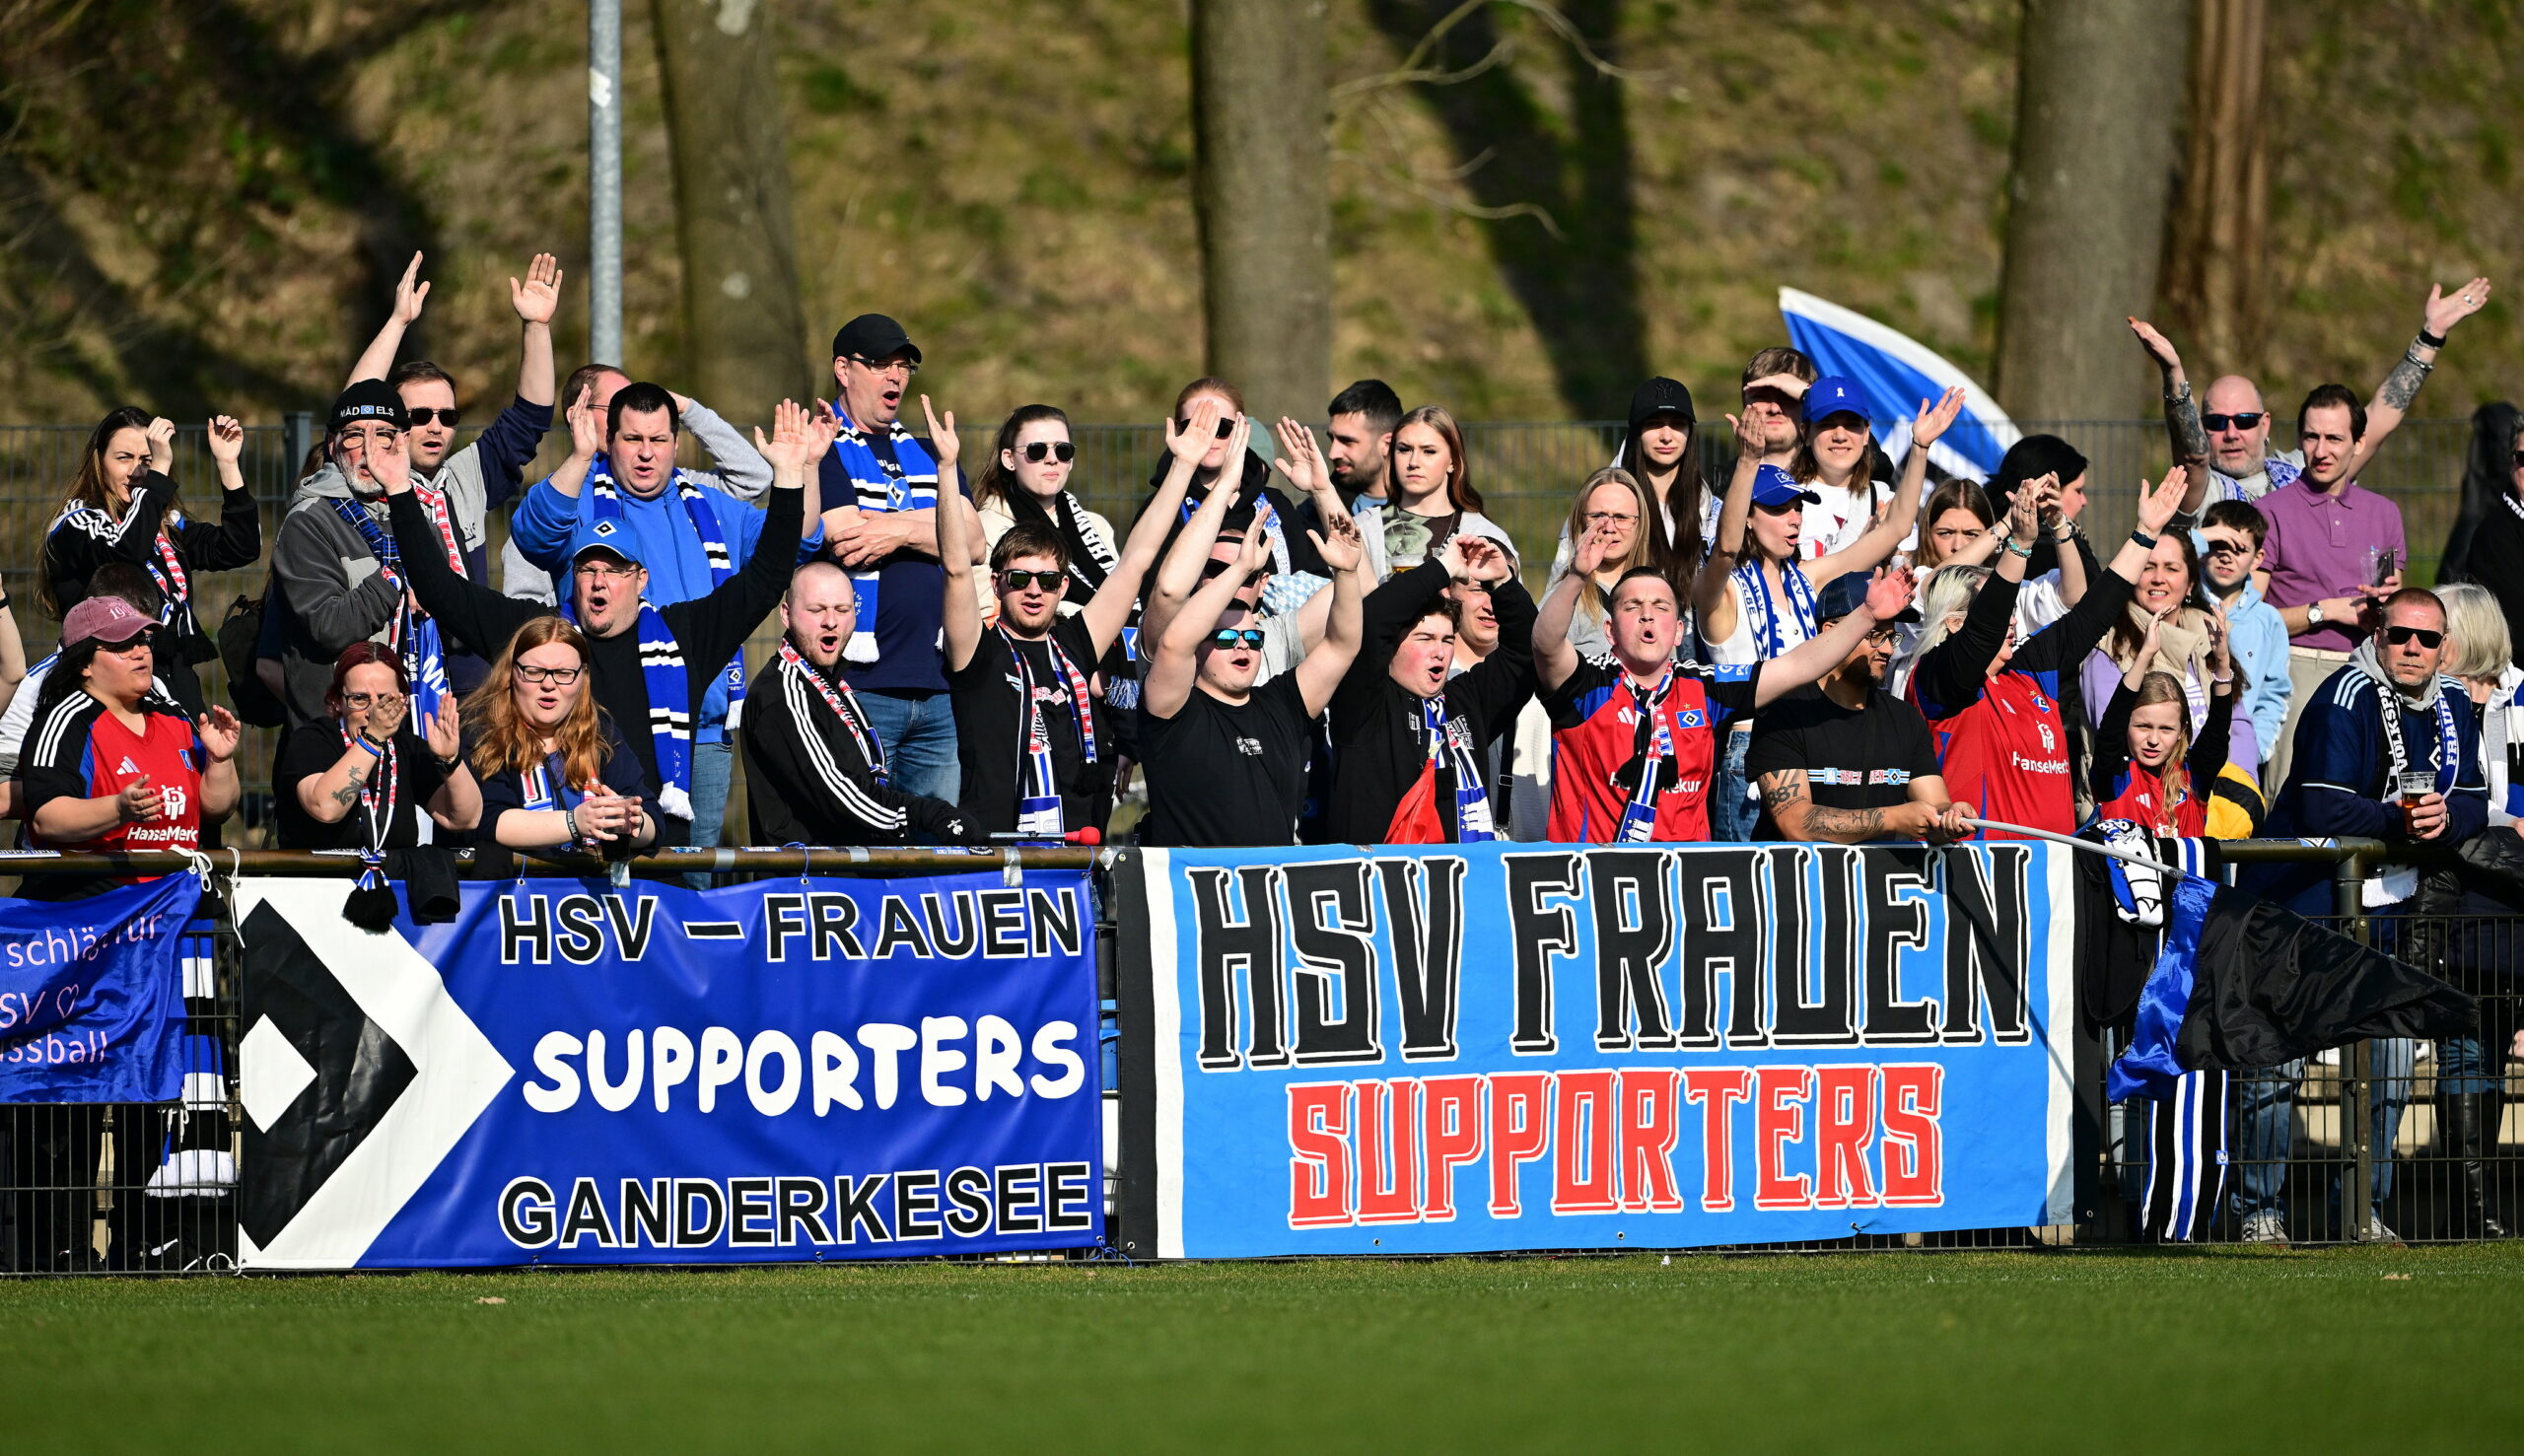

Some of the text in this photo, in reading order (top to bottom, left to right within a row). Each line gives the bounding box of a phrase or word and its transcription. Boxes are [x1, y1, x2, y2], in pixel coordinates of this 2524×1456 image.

[2374, 678, 2409, 773] VOLKSPA
[498, 892, 659, 966] HSV
[763, 886, 1082, 963] FRAUEN
[1184, 844, 2033, 1072] HSV FRAUEN
[523, 1014, 1087, 1118] SUPPORTERS
[1286, 1064, 1946, 1230] SUPPORTERS
[497, 1160, 1093, 1250] GANDERKESEE
